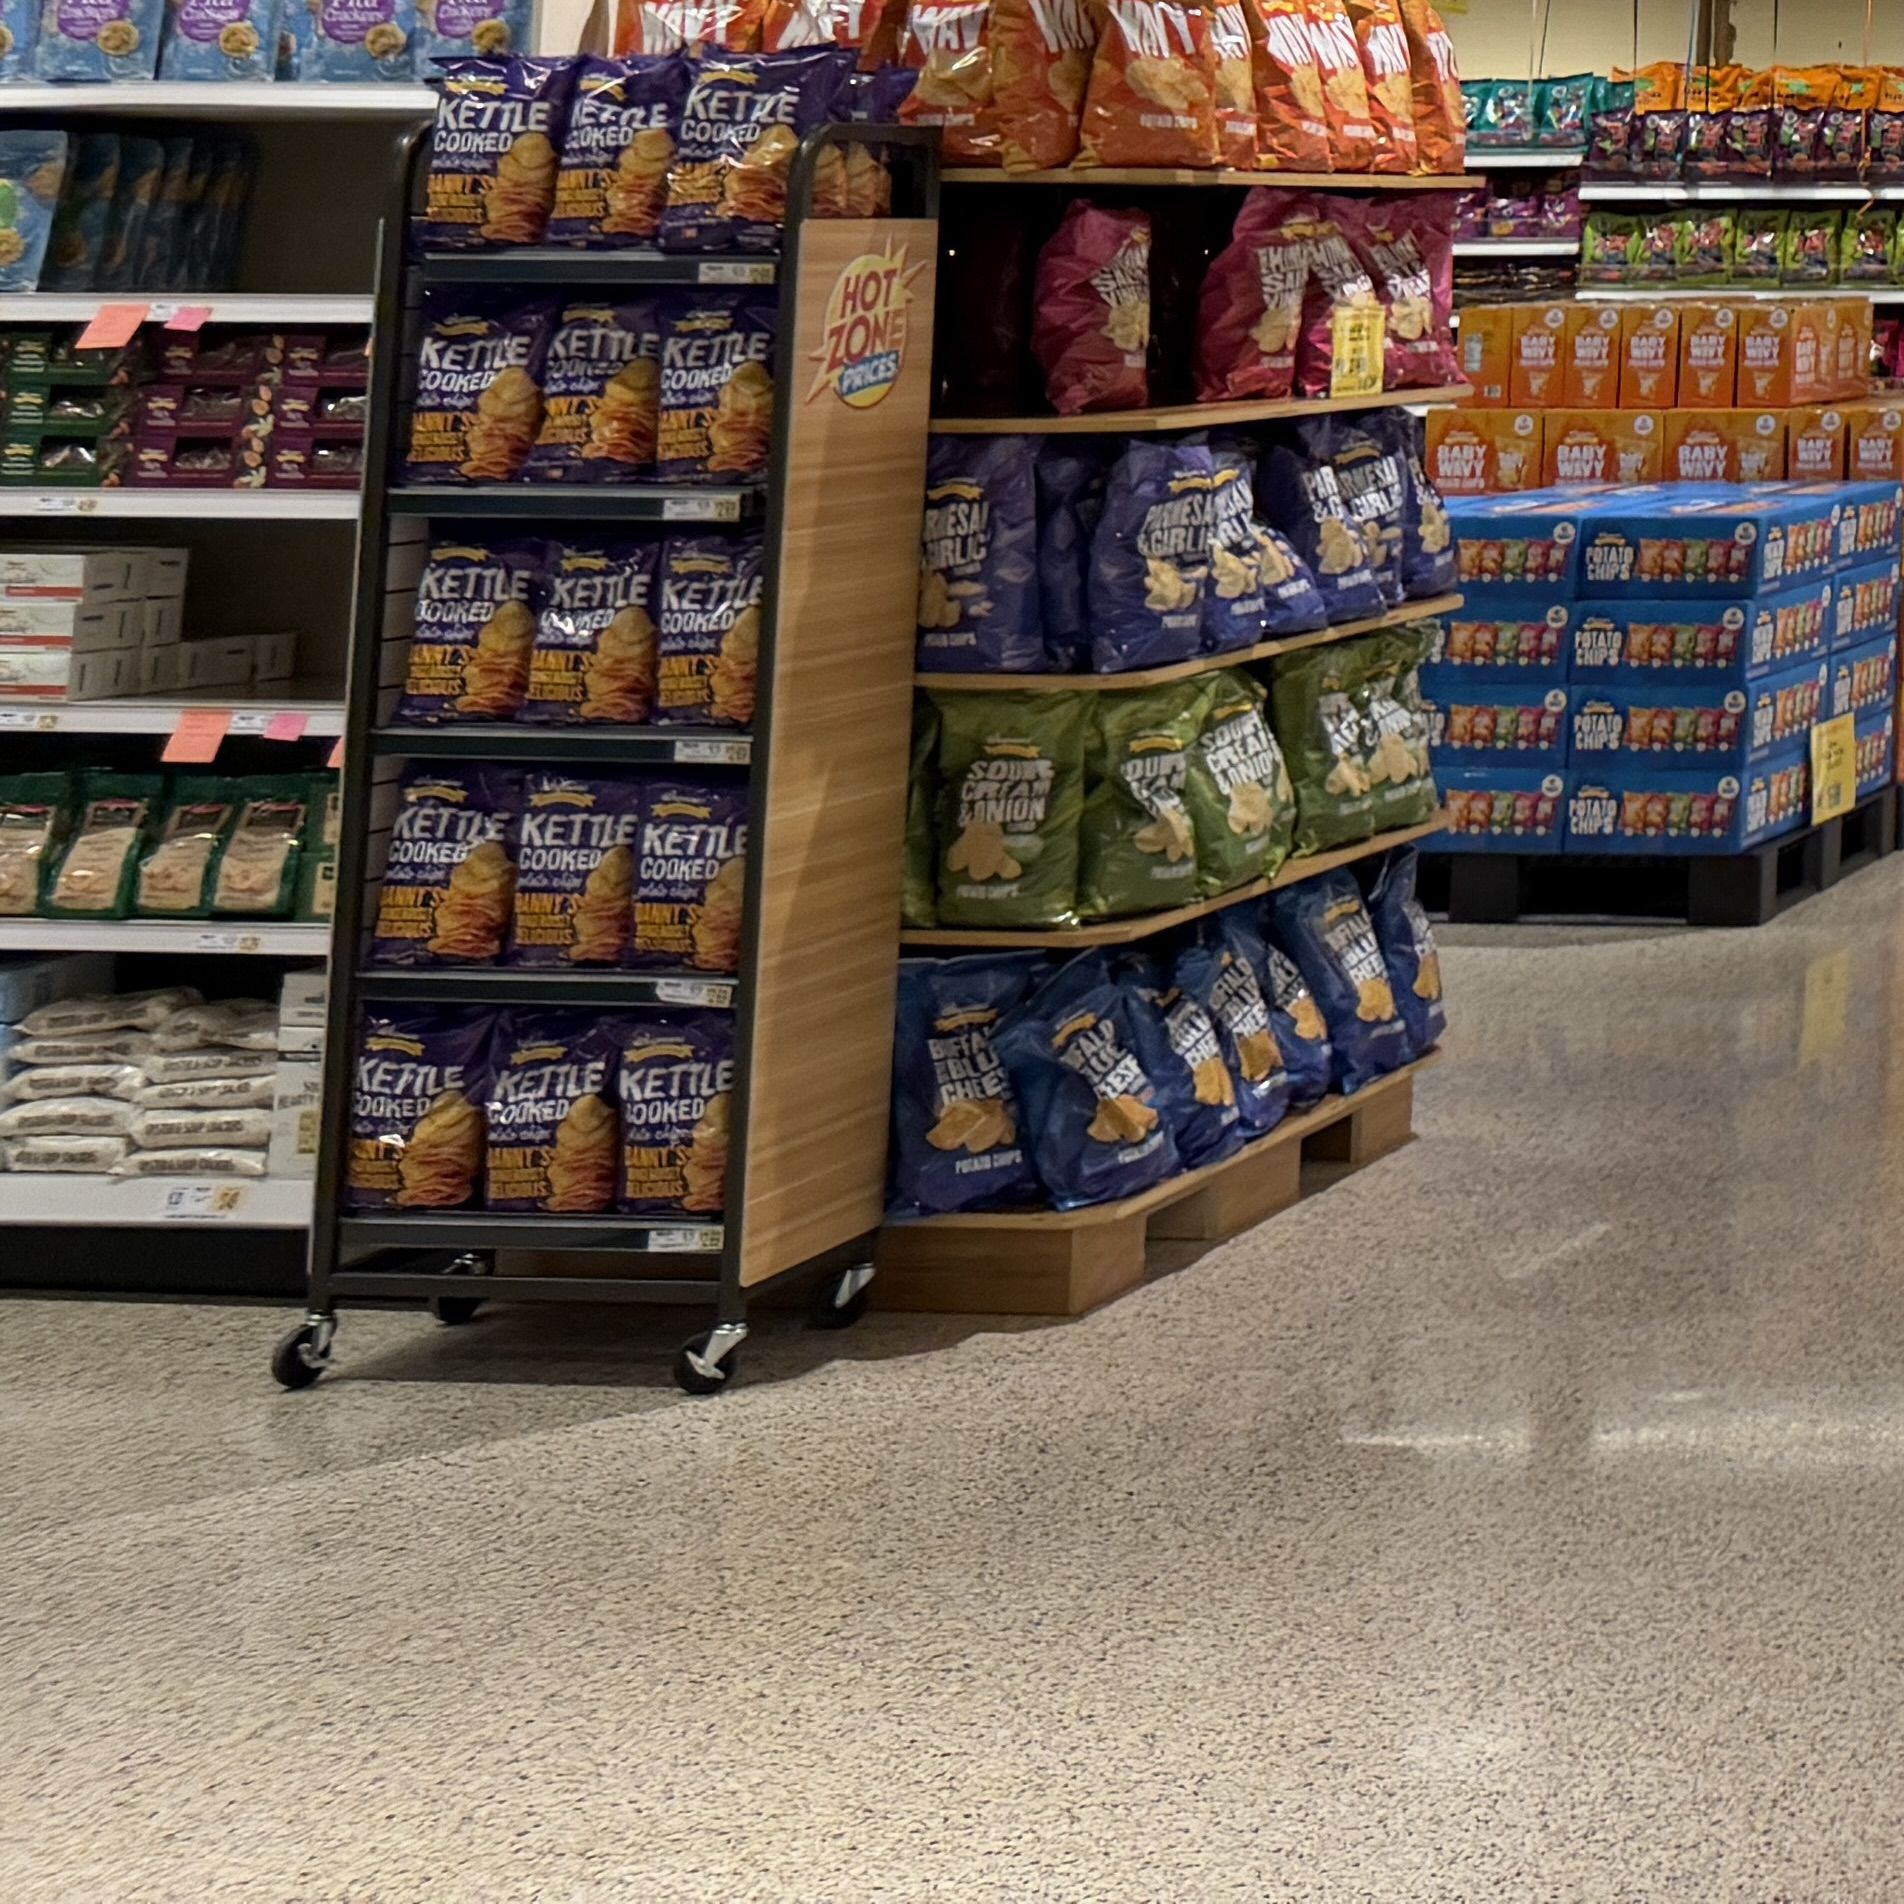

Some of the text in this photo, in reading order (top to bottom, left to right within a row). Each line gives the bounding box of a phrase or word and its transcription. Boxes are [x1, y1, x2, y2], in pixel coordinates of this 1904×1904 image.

[436, 99, 552, 133] KETTLE
[682, 87, 798, 124] KETTLE
[433, 132, 512, 154] COOKED
[680, 123, 761, 144] COOKED
[840, 269, 898, 318] HOT
[419, 334, 532, 370] KETTLE
[662, 332, 770, 366] KETTLE
[827, 308, 904, 373] ZONE
[1520, 336, 1556, 347] BABY
[1630, 336, 1666, 347] BABY
[418, 369, 494, 393] COOKED
[660, 365, 732, 389] COOKED
[841, 355, 897, 393] PRICES
[1438, 445, 1487, 462] BABY
[1557, 445, 1607, 462] BABY
[1585, 546, 1635, 564] POTATO
[420, 567, 532, 601] KETTLE
[1586, 562, 1631, 582] CHIPS
[551, 573, 651, 608] KETTLE
[416, 599, 494, 622] COOKED
[542, 608, 614, 632] COOKED
[1574, 630, 1622, 650] POTATO
[1574, 647, 1619, 667] CHIPS
[1574, 714, 1623, 733] POTATO
[1574, 730, 1620, 750] CHIPS
[1569, 799, 1618, 819] POTATO
[394, 807, 510, 842] KETTLE
[520, 812, 638, 847] KETTLE
[1570, 815, 1614, 836] CHIPS
[388, 841, 466, 864] COOKED
[519, 847, 601, 870] COOKED
[640, 858, 720, 881] COOKED
[357, 1057, 464, 1095] KETTLE
[495, 1062, 605, 1100] KETTLE
[619, 1059, 734, 1101] KETTLE
[352, 1095, 431, 1119] COOKED
[488, 1100, 570, 1124] COOKED
[625, 1099, 705, 1123] COOKED
